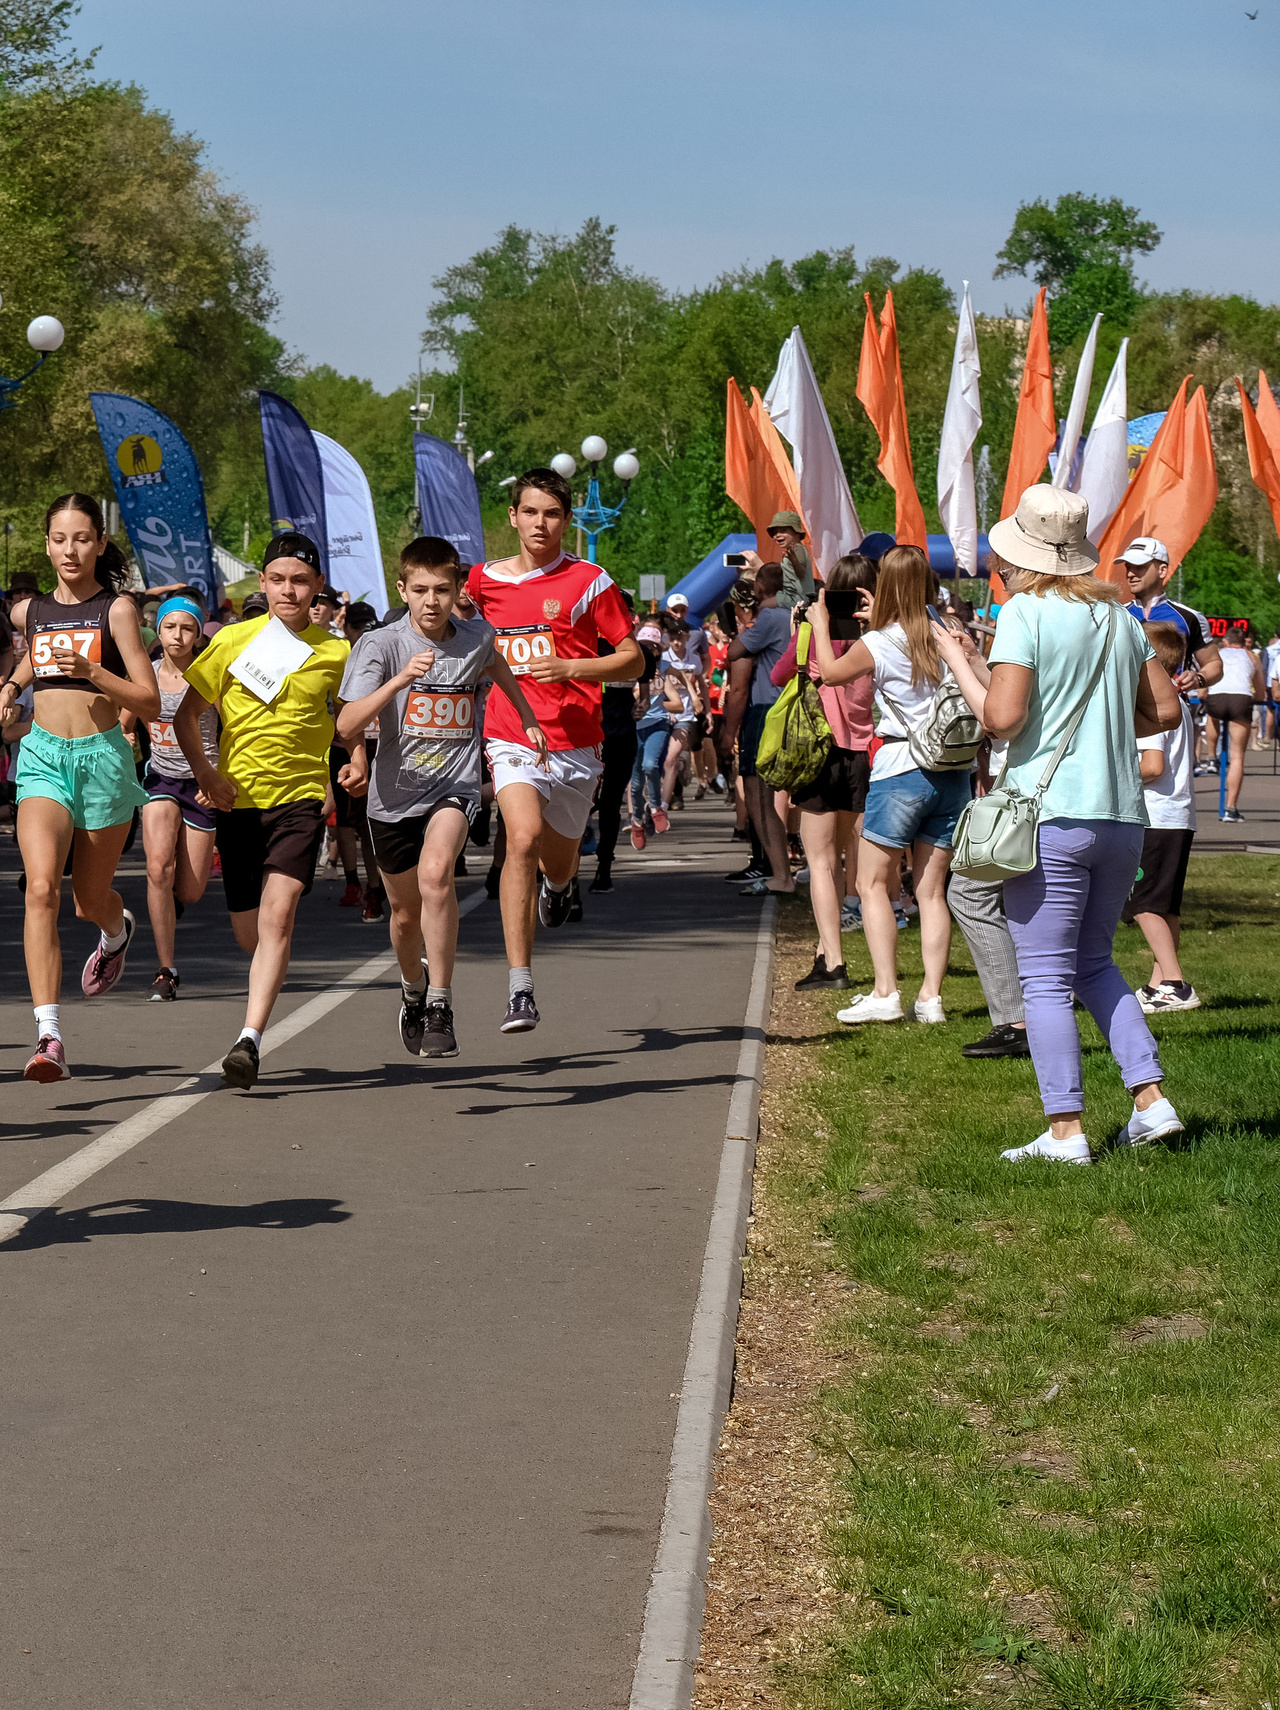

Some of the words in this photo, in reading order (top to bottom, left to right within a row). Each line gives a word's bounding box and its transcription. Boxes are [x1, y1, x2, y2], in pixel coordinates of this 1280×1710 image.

[34, 632, 95, 664] 597
[497, 635, 551, 663] 700
[409, 696, 471, 726] 390
